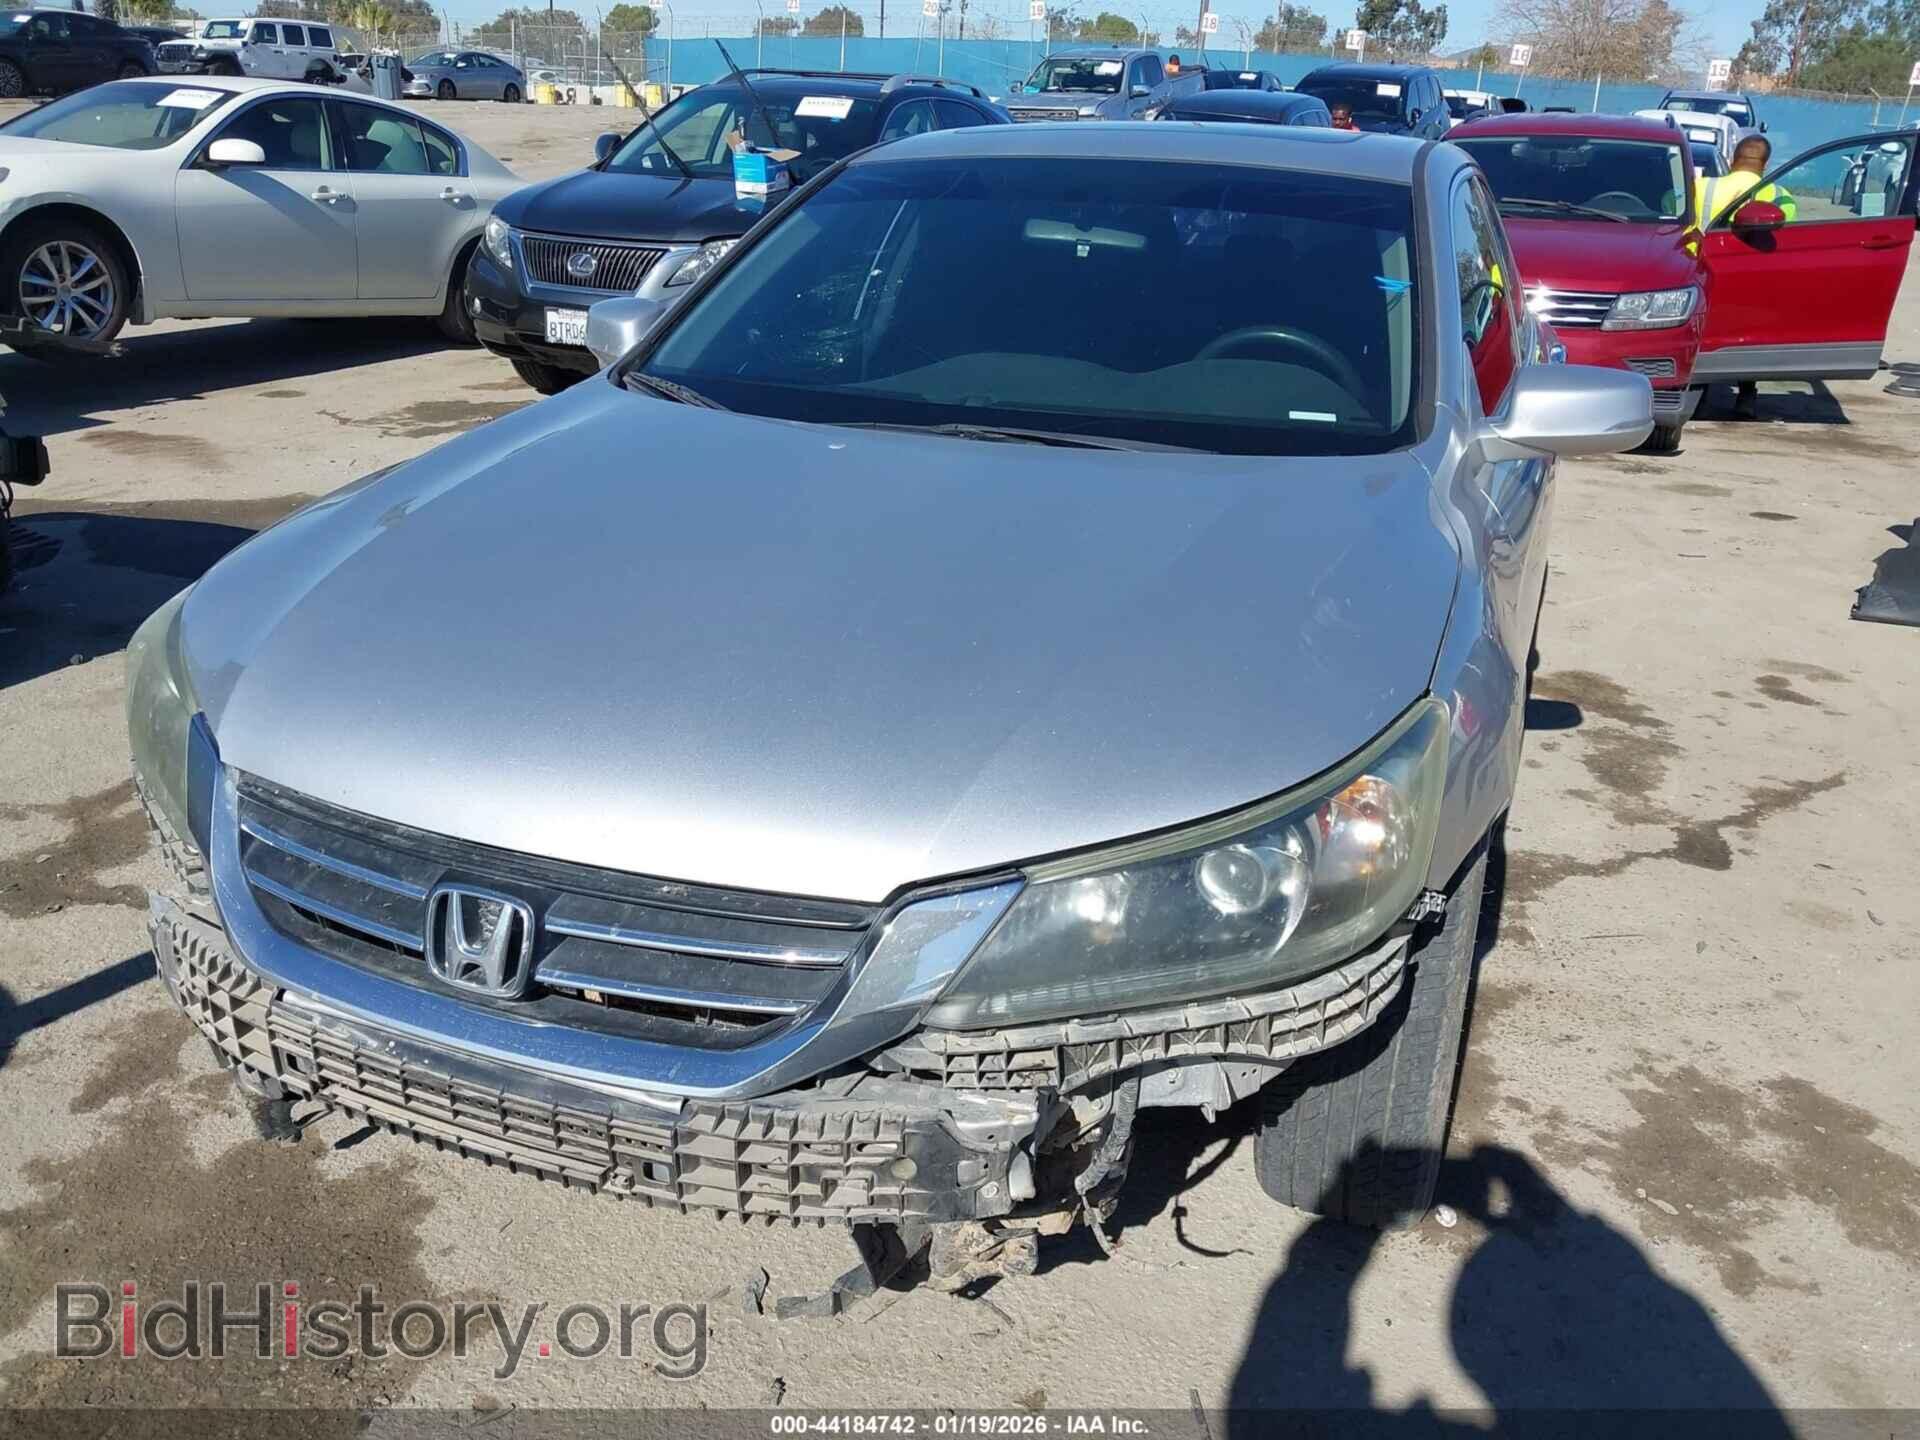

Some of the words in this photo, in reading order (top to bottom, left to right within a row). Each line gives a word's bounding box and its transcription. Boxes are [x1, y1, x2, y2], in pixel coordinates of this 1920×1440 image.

[1204, 16, 1217, 30] 18
[1347, 34, 1362, 46] 17
[1711, 64, 1729, 76] 15
